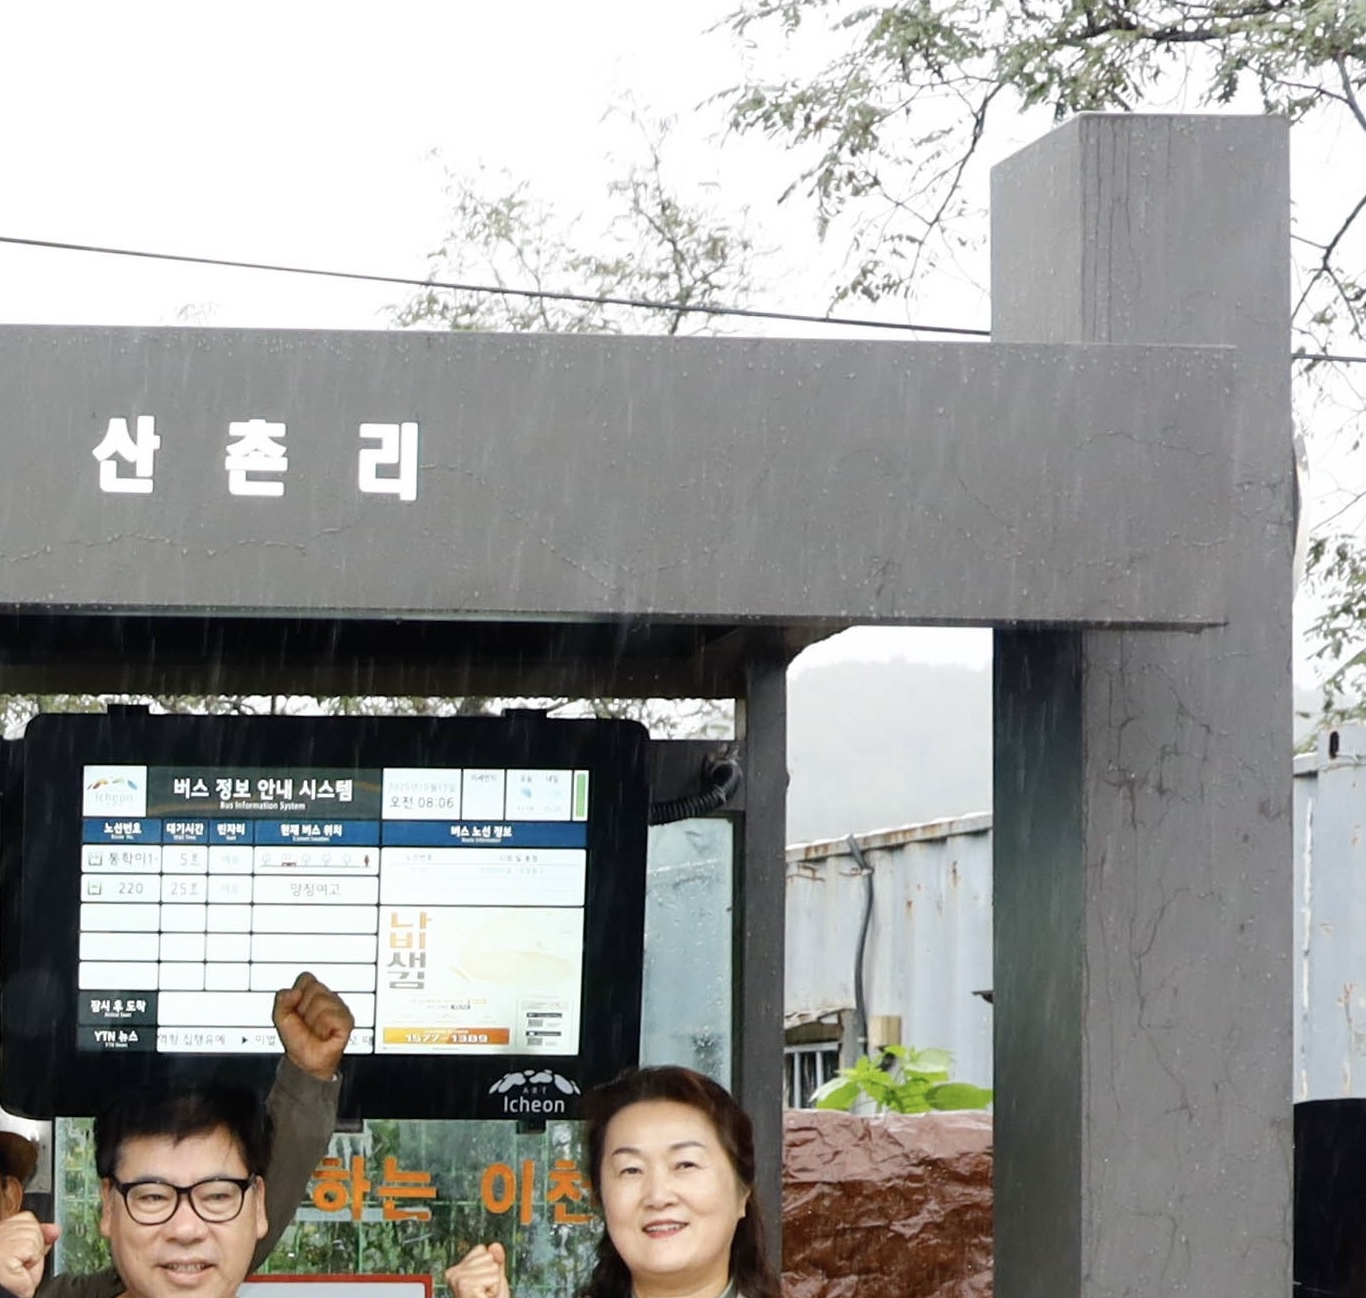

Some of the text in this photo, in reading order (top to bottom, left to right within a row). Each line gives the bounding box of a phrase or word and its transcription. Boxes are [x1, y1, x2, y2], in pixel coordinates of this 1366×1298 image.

[173, 779, 353, 801] 버스 정보 안내 시스템
[389, 796, 454, 809] 오전 08:06
[103, 822, 142, 834] 노선번호
[166, 822, 204, 835] 대기시간
[471, 825, 491, 838] 노선
[118, 882, 143, 894] 220
[94, 1030, 138, 1042] YTN 뉴스
[503, 1096, 565, 1113] Icheon
